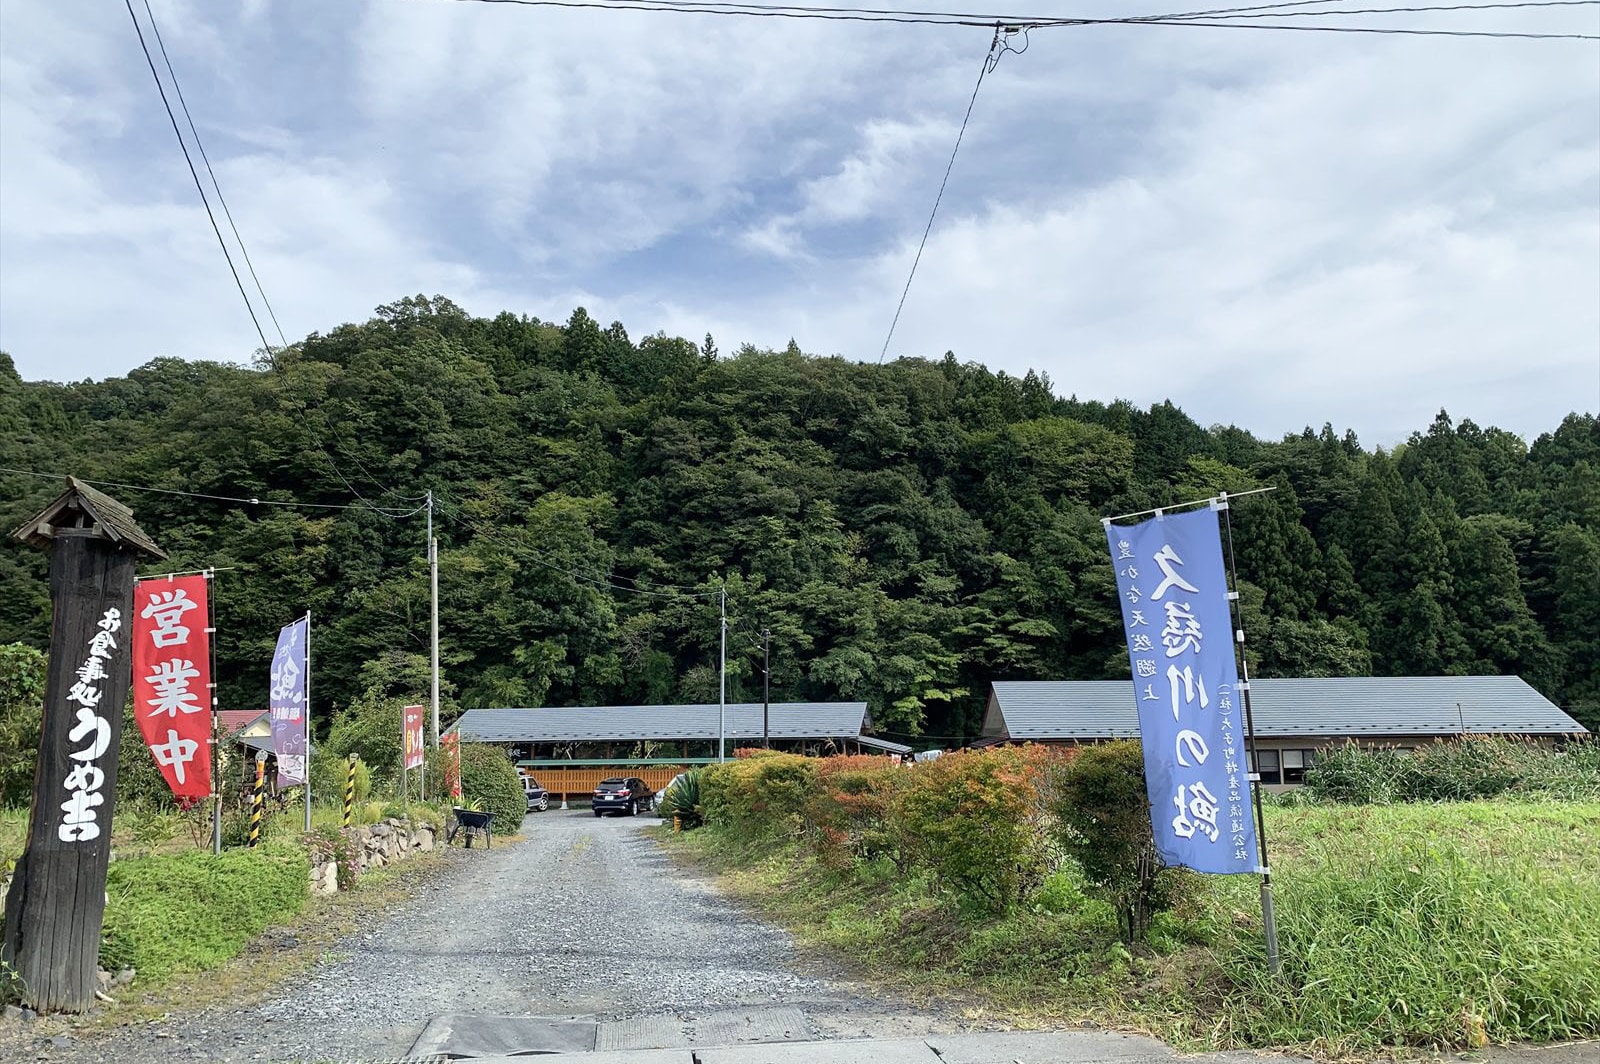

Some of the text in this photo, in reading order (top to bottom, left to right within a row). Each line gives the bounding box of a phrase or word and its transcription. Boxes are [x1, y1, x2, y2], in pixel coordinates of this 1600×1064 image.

[58, 607, 122, 843] お食事処 うめ吉
[140, 588, 204, 785] 営業中
